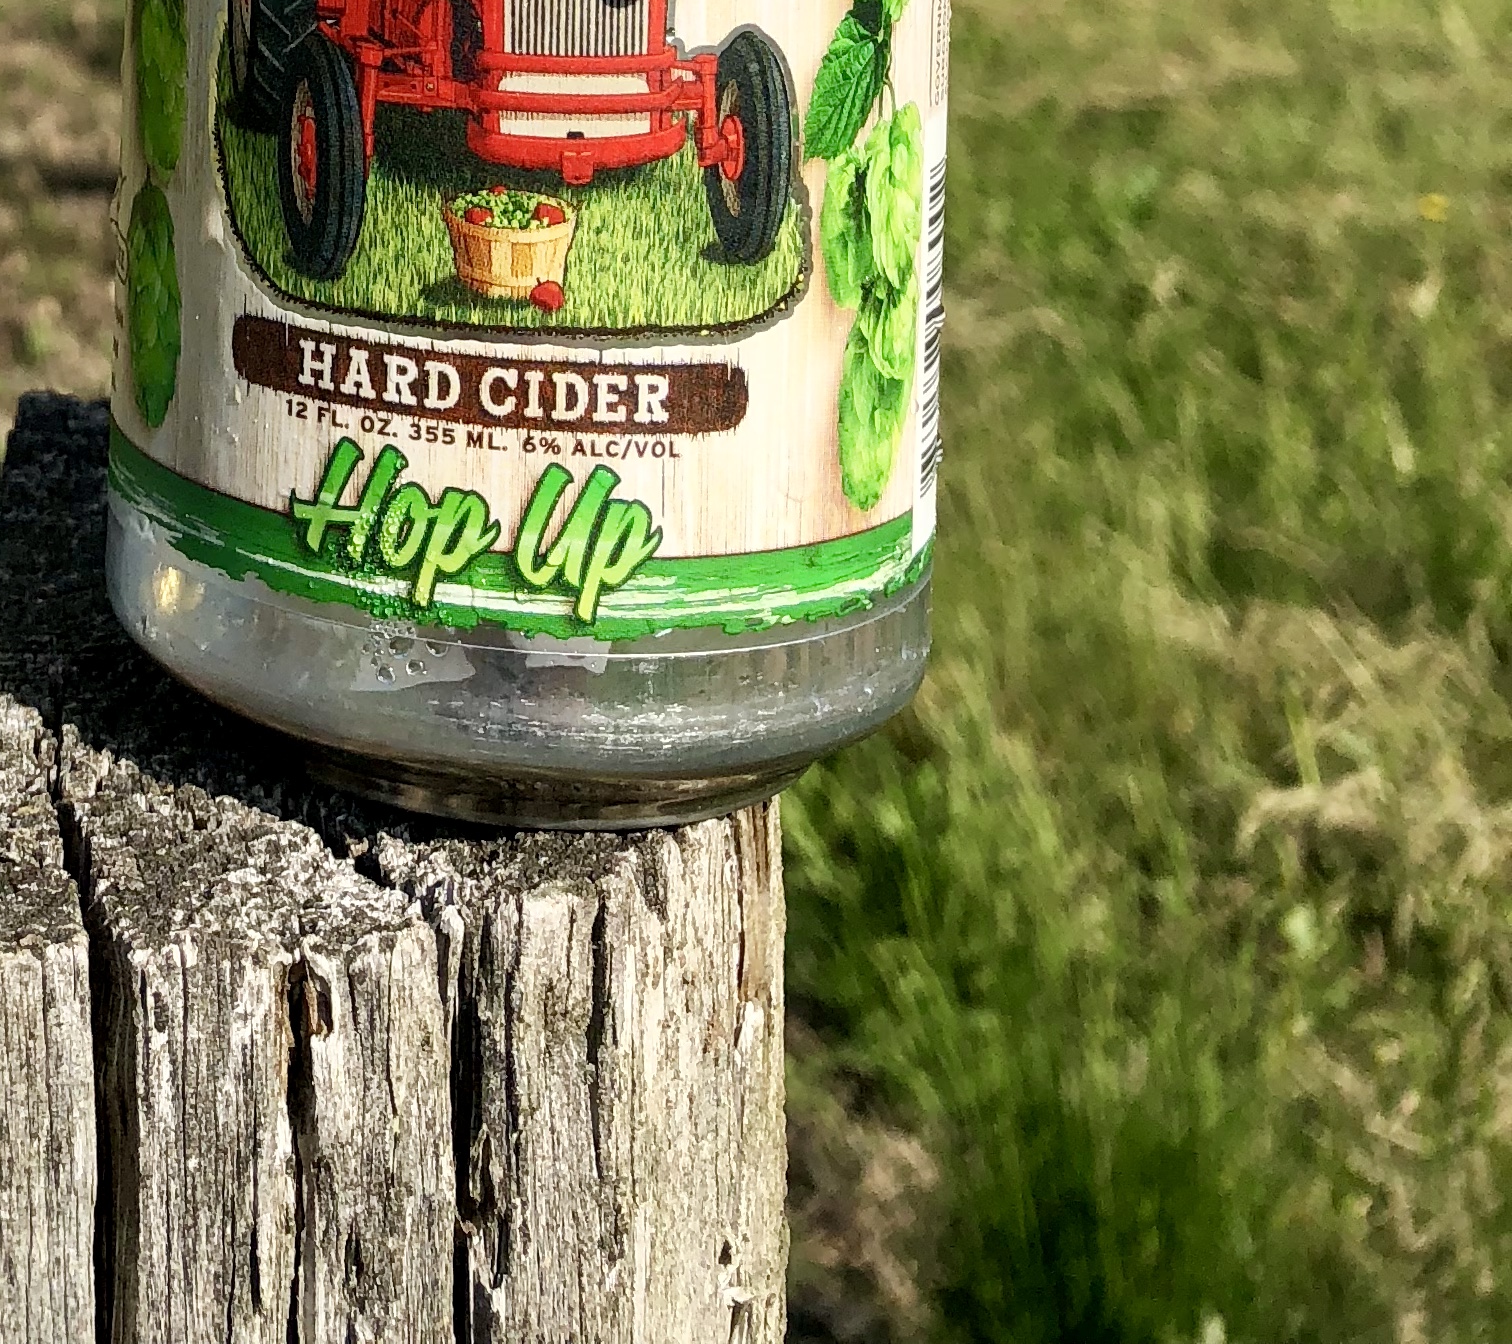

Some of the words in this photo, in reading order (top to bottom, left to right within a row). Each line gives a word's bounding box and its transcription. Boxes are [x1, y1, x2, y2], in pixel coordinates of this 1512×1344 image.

[296, 336, 462, 412] HARD
[479, 367, 671, 425] CIDER
[285, 398, 308, 420] 12
[316, 408, 350, 430] FL.
[360, 418, 398, 438] OZ.
[408, 423, 456, 446] 355
[465, 430, 509, 453] ML.
[522, 436, 563, 456] 6%
[570, 438, 682, 460] ALC/VOL
[290, 435, 502, 609] Hop
[512, 461, 664, 627] Up
